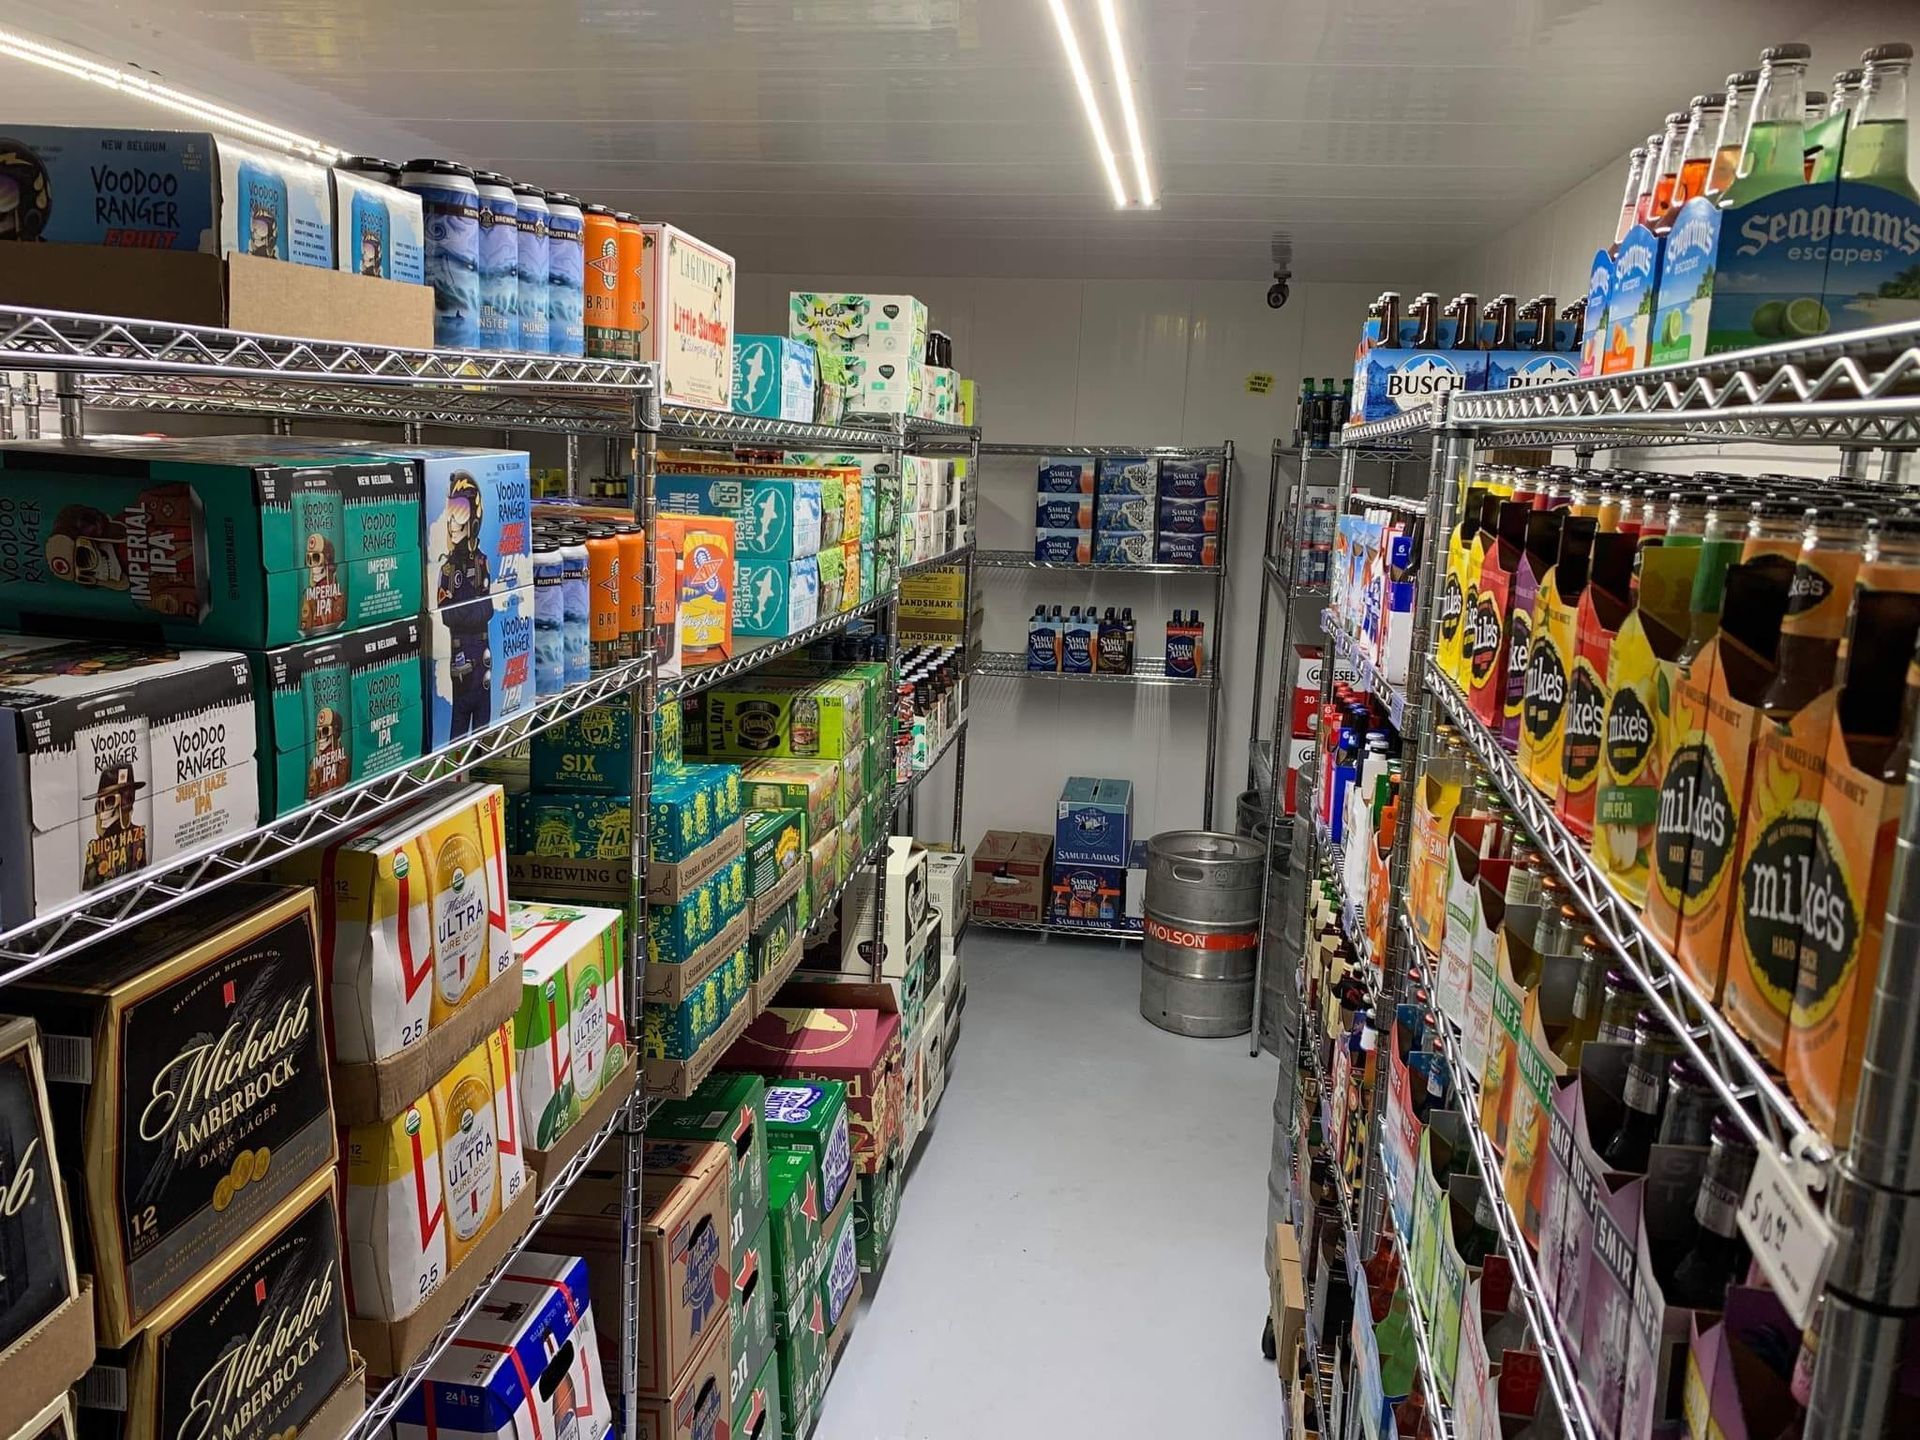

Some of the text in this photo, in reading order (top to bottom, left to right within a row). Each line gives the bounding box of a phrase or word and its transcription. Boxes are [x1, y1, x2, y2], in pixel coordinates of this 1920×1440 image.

[102, 140, 166, 152] NEW BELGIUM
[91, 165, 178, 198] VOODOO
[249, 182, 279, 201] VOODOO
[96, 197, 180, 228] RANGER
[1737, 204, 1920, 256] Seagram's
[1788, 247, 1883, 266] escapes
[673, 302, 697, 338] Little
[734, 344, 742, 400] Dogfish
[1387, 374, 1464, 398] BUSCH
[357, 475, 371, 486] NEW
[1051, 477, 1072, 485] ADAMS
[1173, 472, 1199, 480] SAMUEL
[1174, 479, 1196, 487] ADAMS
[496, 481, 525, 501] VOODOO
[719, 483, 738, 508] 95
[302, 501, 333, 517] VOODOO
[498, 501, 526, 522] RANGER
[743, 488, 754, 540] Dogfish
[1050, 512, 1070, 520] ADAMS
[1171, 508, 1198, 517] SAMUEL
[1174, 515, 1195, 523] ADAMS
[303, 515, 335, 533] RANGER
[360, 512, 397, 532] VOODOO
[731, 509, 749, 551] Head
[1, 500, 16, 584] VOODOO
[20, 501, 45, 584] RANGER
[125, 502, 151, 601] IMPERIAL
[362, 530, 397, 553] RANGER
[1046, 541, 1071, 549] SAMUEL
[1048, 547, 1069, 556] ADAMS
[1170, 544, 1196, 552] SAMUEL
[151, 533, 177, 575] IPA
[367, 555, 398, 574] IMPERIAL
[500, 552, 519, 577] IPA
[1171, 550, 1193, 558] ADAMS
[305, 583, 342, 600] IMPERIAL
[376, 572, 390, 591] IPA
[739, 566, 751, 618] Dogfish
[1789, 573, 1825, 597] ke's
[316, 597, 332, 616] IPA
[900, 599, 953, 609] LANDSHARK
[501, 616, 530, 638] VOODOO
[900, 632, 953, 642] LANDSHARK
[365, 641, 377, 653] NEW
[503, 634, 530, 659] RANGER
[311, 675, 341, 692] VOODOO
[367, 674, 400, 696] VOODOO
[1311, 668, 1357, 682] GEESEE
[1529, 656, 1563, 703] mike's
[313, 690, 343, 709] RANGER
[368, 691, 402, 717] RANGER
[504, 685, 522, 707] IPA
[823, 698, 831, 707] 15
[1304, 695, 1315, 704] 30
[1325, 706, 1332, 714] 6
[370, 711, 399, 733] IMPERIAL
[712, 699, 727, 751] ALL DAY
[1608, 708, 1648, 743] mike's
[90, 729, 136, 752] VOODOO
[173, 724, 226, 757] VOODOO
[378, 728, 391, 747] IPA
[94, 746, 138, 774] RANGER
[176, 747, 228, 784] RANGER
[313, 749, 346, 766] IMPERIAL
[561, 754, 596, 773] SIX
[322, 764, 337, 782] IPA
[580, 772, 603, 782] CANS
[175, 771, 228, 804] JUICY HAZE
[787, 785, 795, 795] 15
[194, 795, 213, 817] IPA
[1659, 777, 1726, 847] mike's
[87, 833, 117, 862] JUICY
[119, 826, 146, 848] HAZE
[753, 839, 774, 861] TORPEDO
[108, 848, 127, 869] IPA
[1058, 850, 1120, 863] SAMUEL ADAMS
[530, 864, 610, 884] BREWING
[1071, 878, 1098, 887] SAMUEL
[335, 881, 348, 891] 12
[1750, 855, 1845, 952] mike's
[438, 899, 484, 944] ULTRA
[1056, 917, 1111, 929] SAMUEL ADAMS
[441, 936, 461, 954] PURE
[1150, 922, 1206, 948] MOLSON
[1772, 935, 1796, 961] HARD
[498, 950, 510, 973] 85
[173, 971, 221, 1014] MICHELOB
[402, 1018, 423, 1048] 2.5
[574, 1008, 603, 1046] ULTRA
[140, 985, 311, 1142] Michelob
[174, 1054, 296, 1159] AMBERBOCK
[555, 1105, 569, 1129] 4%
[199, 1102, 278, 1169] DARK LAGER
[449, 1132, 492, 1186] ULTRA
[1550, 1111, 1600, 1213] SMIRNOFF
[452, 1156, 491, 1200] PURE GOLD
[509, 1170, 520, 1195] 85
[130, 1206, 158, 1238] 12
[419, 1263, 439, 1294] 2.5
[268, 1382, 304, 1417] LAGER
[446, 1391, 480, 1404] 24 12
